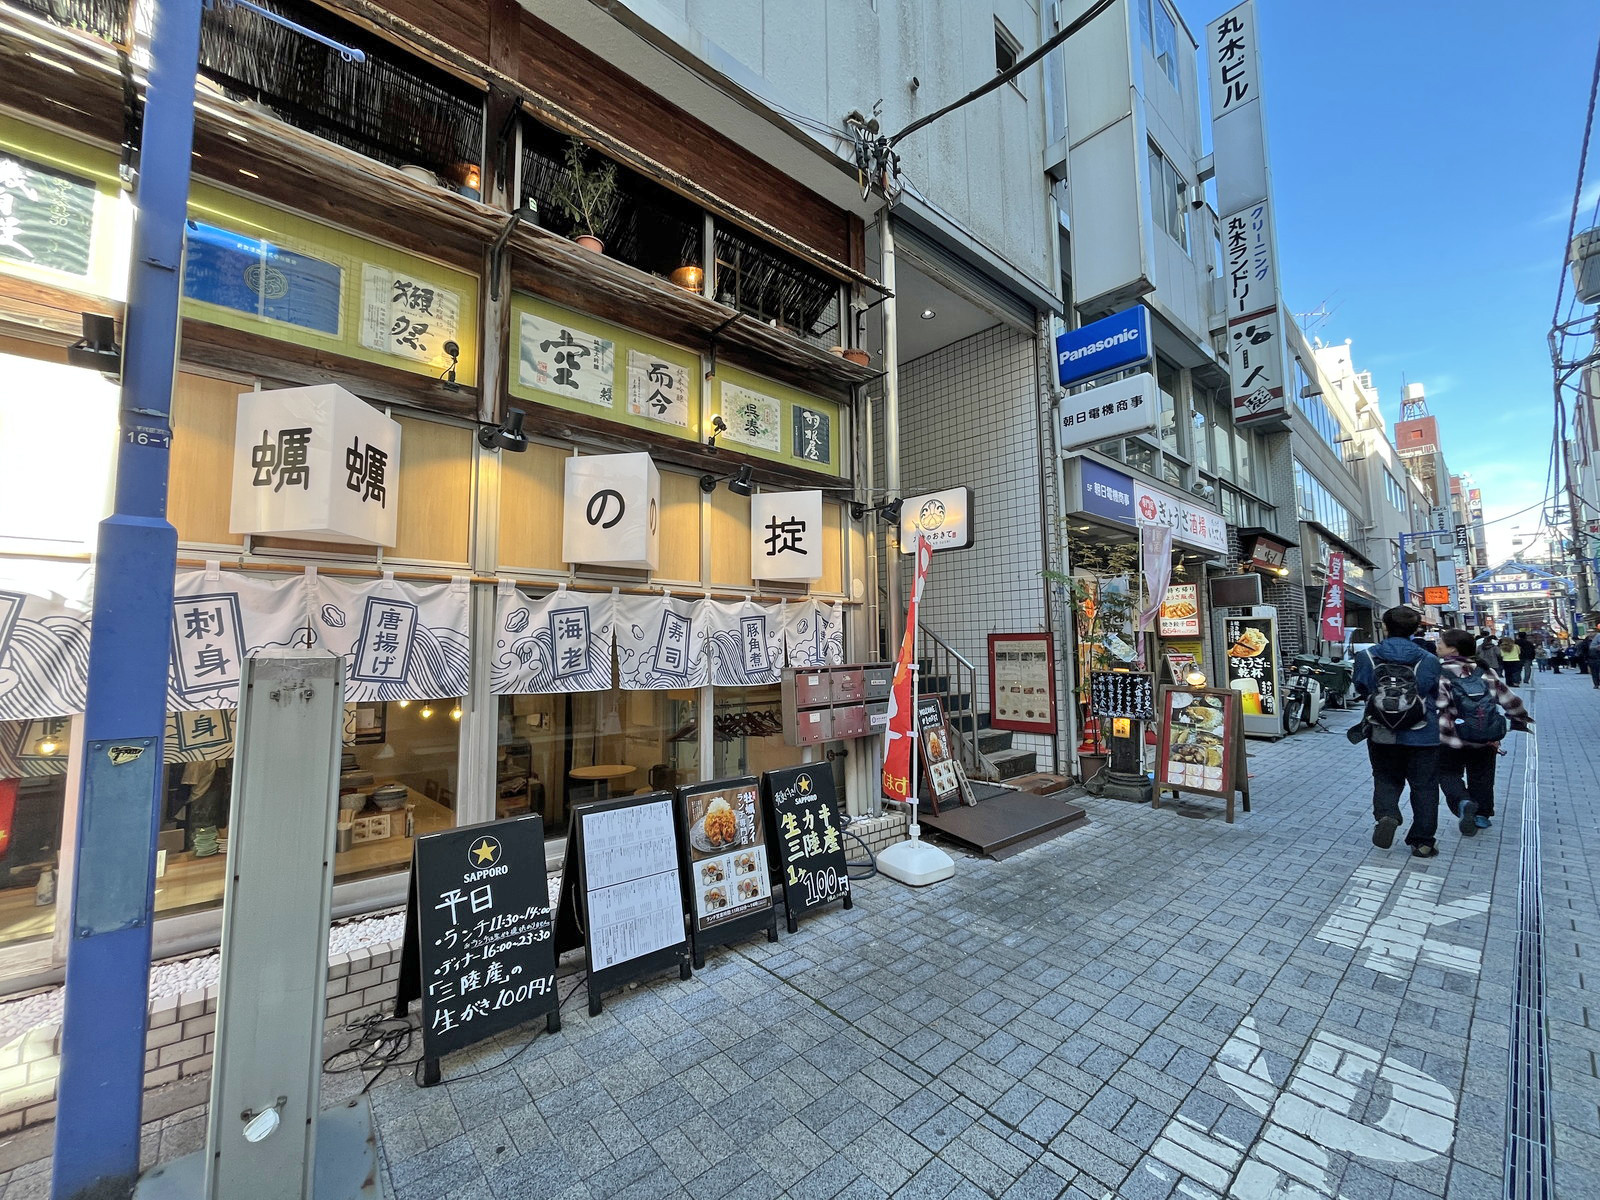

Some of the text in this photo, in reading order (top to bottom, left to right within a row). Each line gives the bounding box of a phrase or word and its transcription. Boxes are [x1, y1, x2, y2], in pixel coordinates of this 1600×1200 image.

[1251, 206, 1269, 281] クリーニング
[540, 329, 591, 389] 空
[1059, 328, 1139, 365] Panasonic
[646, 363, 674, 415] 而今
[744, 403, 761, 437] 呉春
[1063, 394, 1144, 427] 朝日電機商事
[586, 489, 625, 529] の
[764, 516, 807, 556] 掟
[183, 606, 230, 678] 刺身
[371, 607, 404, 676] 唐揚げ
[558, 616, 583, 669] 海老
[664, 620, 684, 669] 寿司
[745, 622, 763, 667] 豚角煮
[1230, 657, 1271, 668] ぎょうざに
[1237, 668, 1265, 678] 乾杯
[781, 803, 831, 840] 生カキ
[787, 825, 841, 863] 三陸産
[463, 864, 509, 884] SAPPORO
[435, 884, 494, 926] 平日
